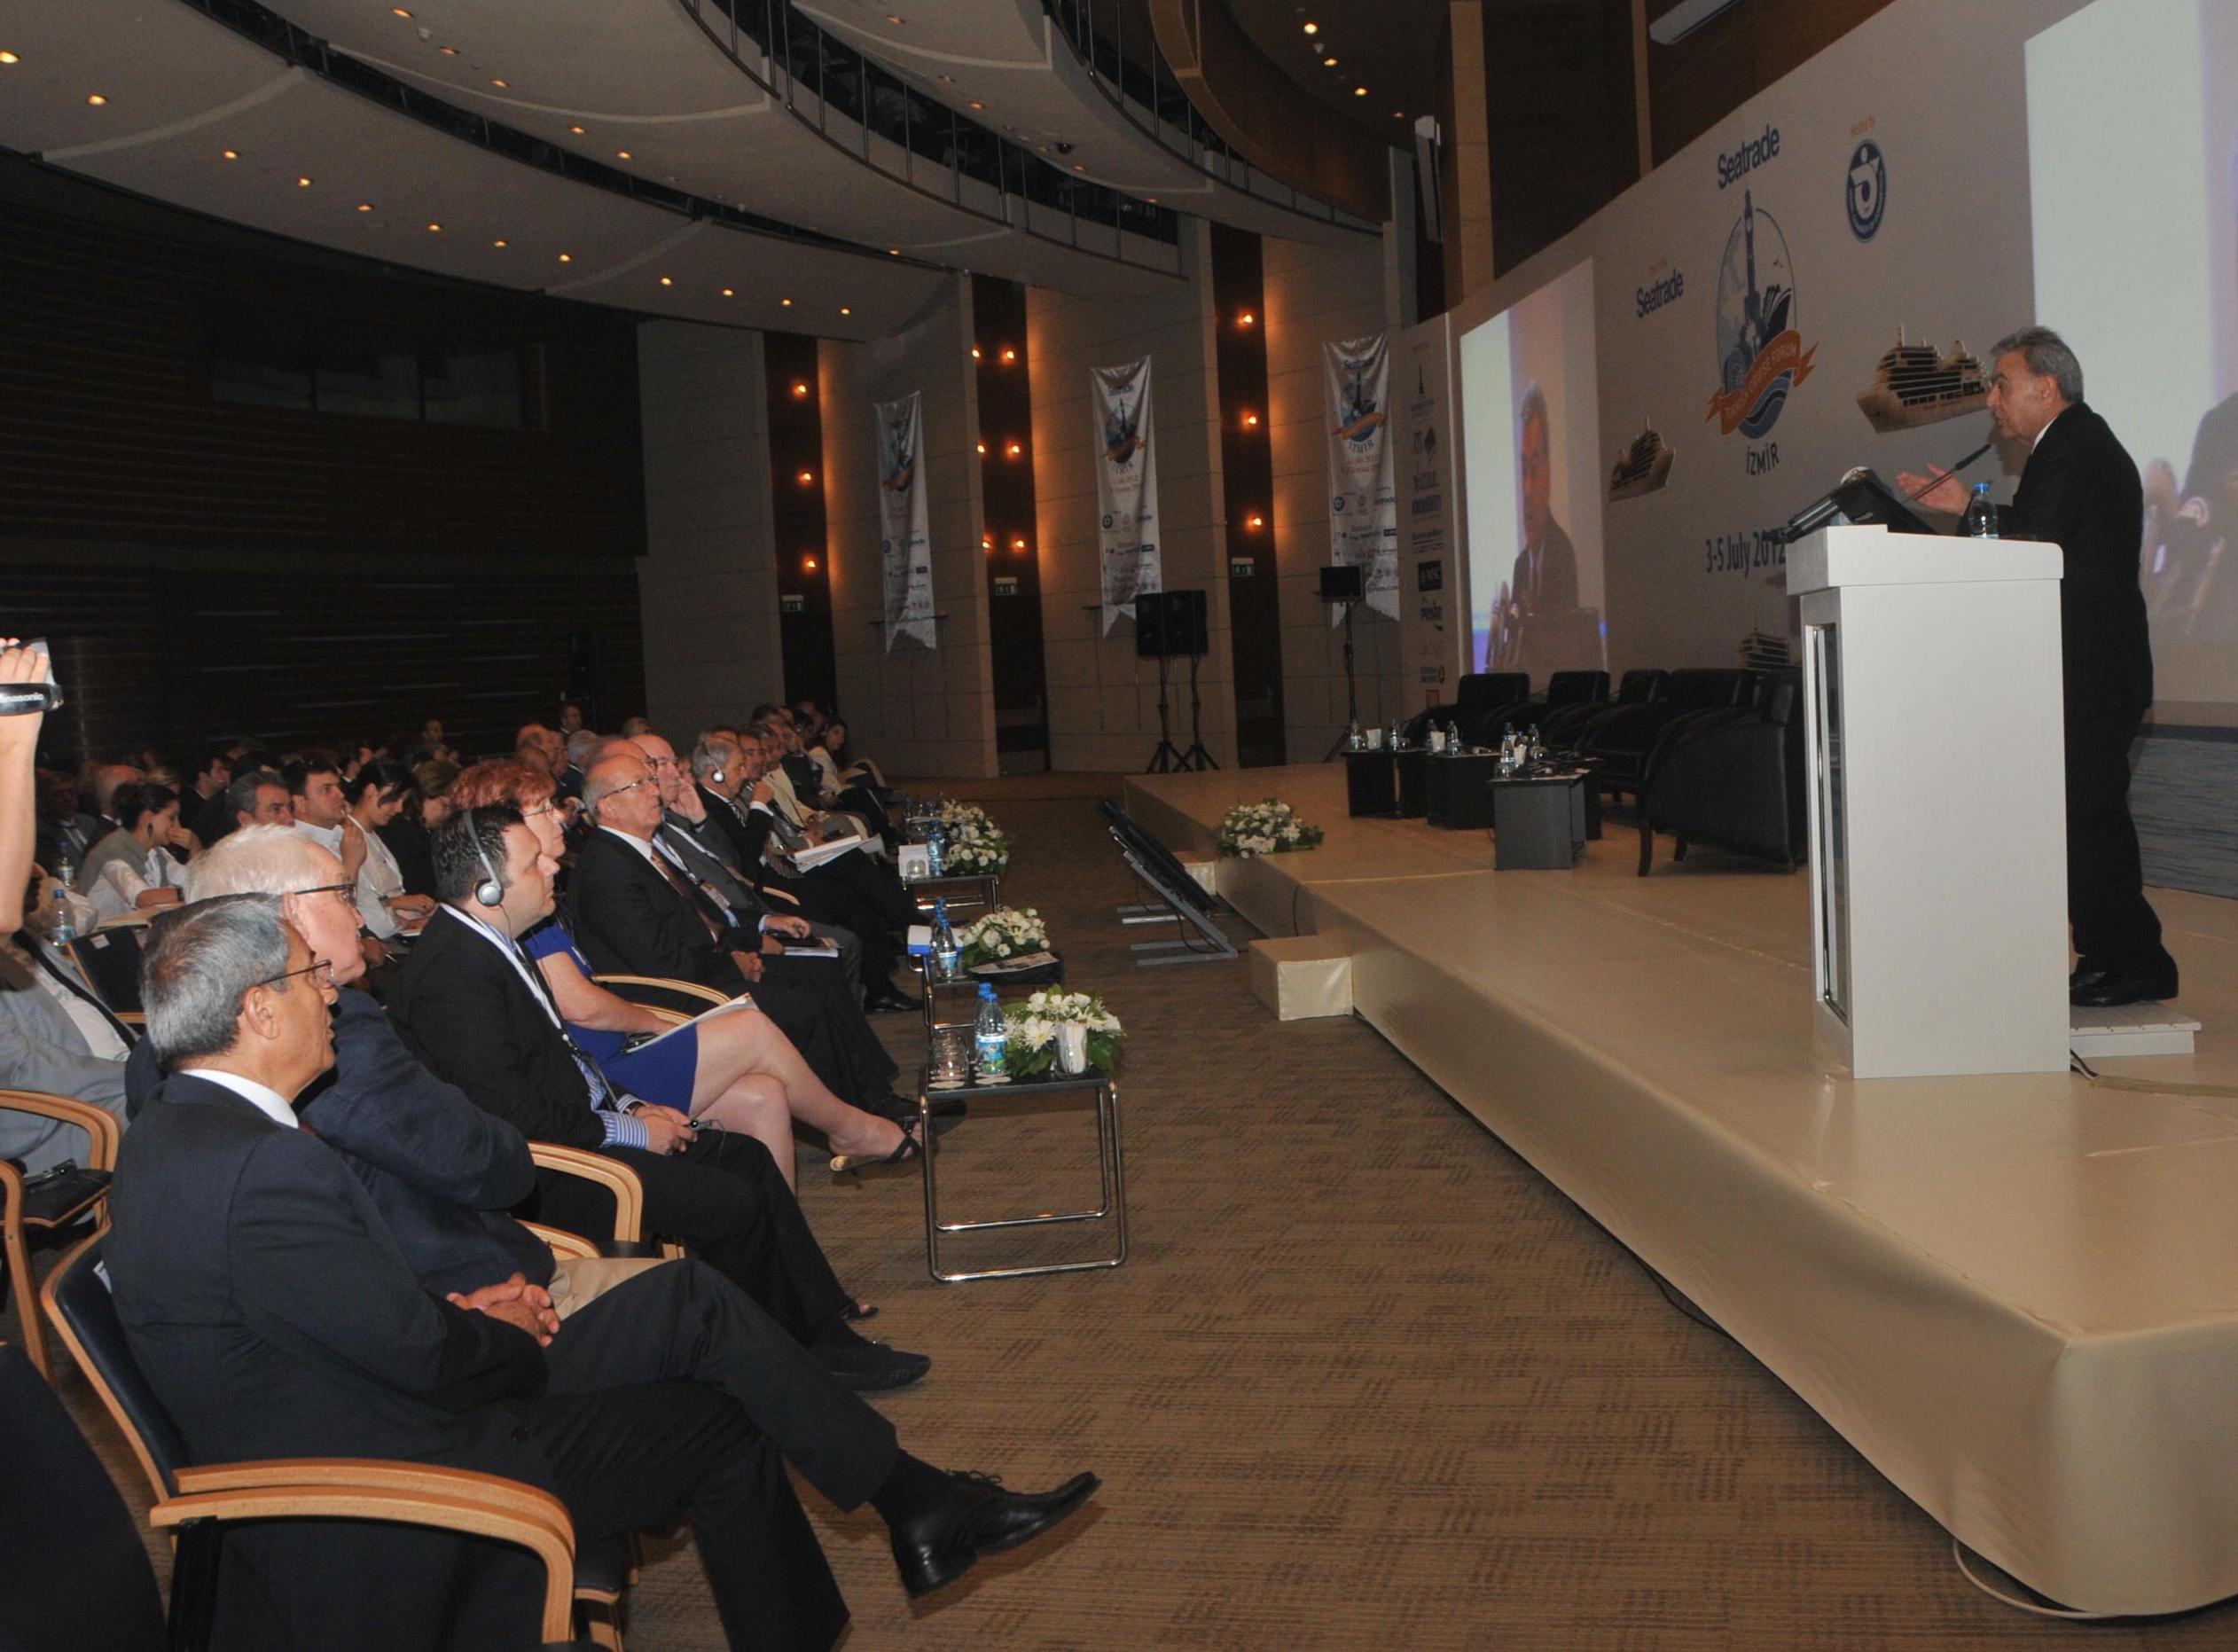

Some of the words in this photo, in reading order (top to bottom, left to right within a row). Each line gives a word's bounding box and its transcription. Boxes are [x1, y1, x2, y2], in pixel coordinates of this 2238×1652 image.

[1718, 123, 1780, 190] Seatrade
[1637, 268, 1684, 317] Seatrade
[1746, 442, 1780, 476] İZMİR
[1727, 532, 1751, 579] July
